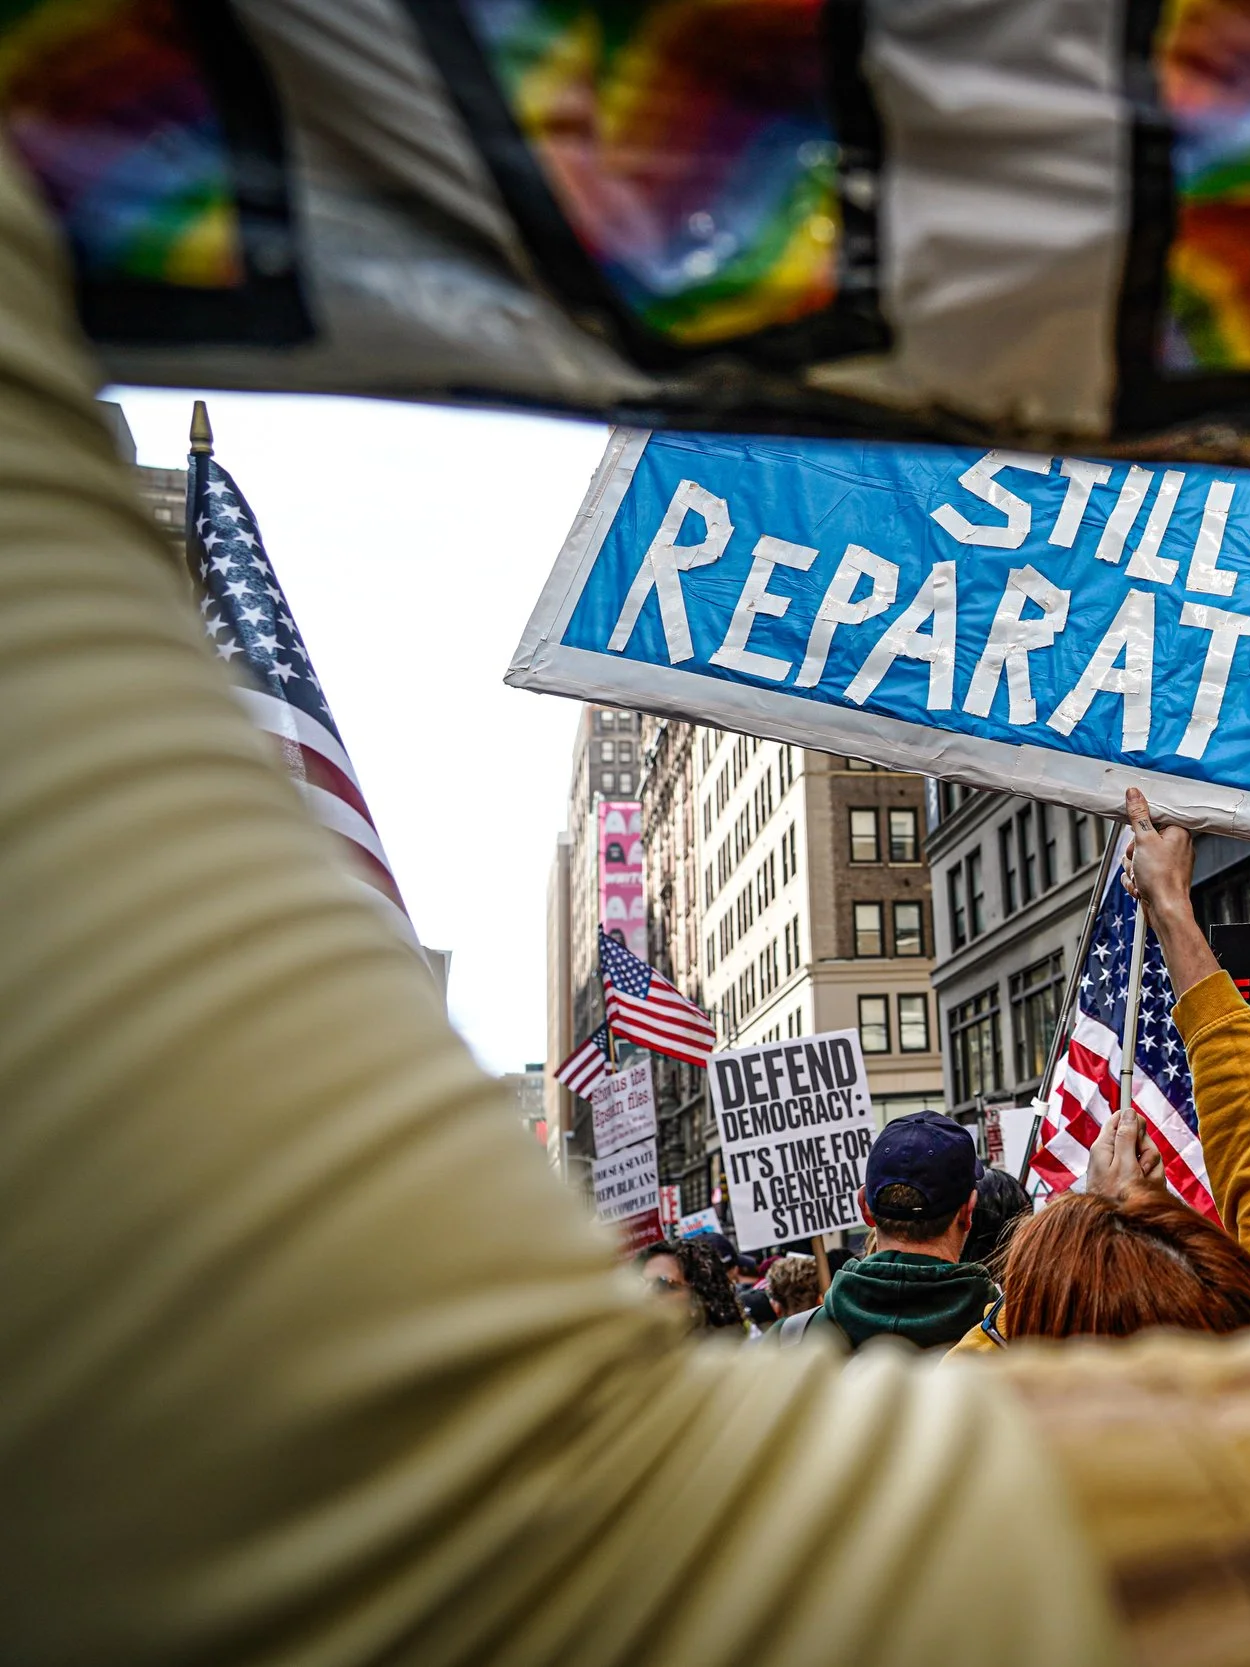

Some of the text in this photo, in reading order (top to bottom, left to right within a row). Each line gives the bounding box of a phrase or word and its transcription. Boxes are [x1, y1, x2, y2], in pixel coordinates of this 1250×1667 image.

[931, 449, 1238, 597] STILL
[611, 1076, 627, 1093] us
[630, 1067, 647, 1087] the
[715, 1037, 858, 1111] DEFEND
[722, 1088, 866, 1143] DEMOCRACY:
[625, 1150, 654, 1169] SENATE
[730, 1127, 873, 1185] IT'S TIME FOR
[595, 1169, 656, 1203] REPUBLICANS
[613, 1191, 657, 1218] COMPLICIT
[752, 1161, 865, 1213] A GENERAL
[771, 1192, 858, 1240] STRIKE!
